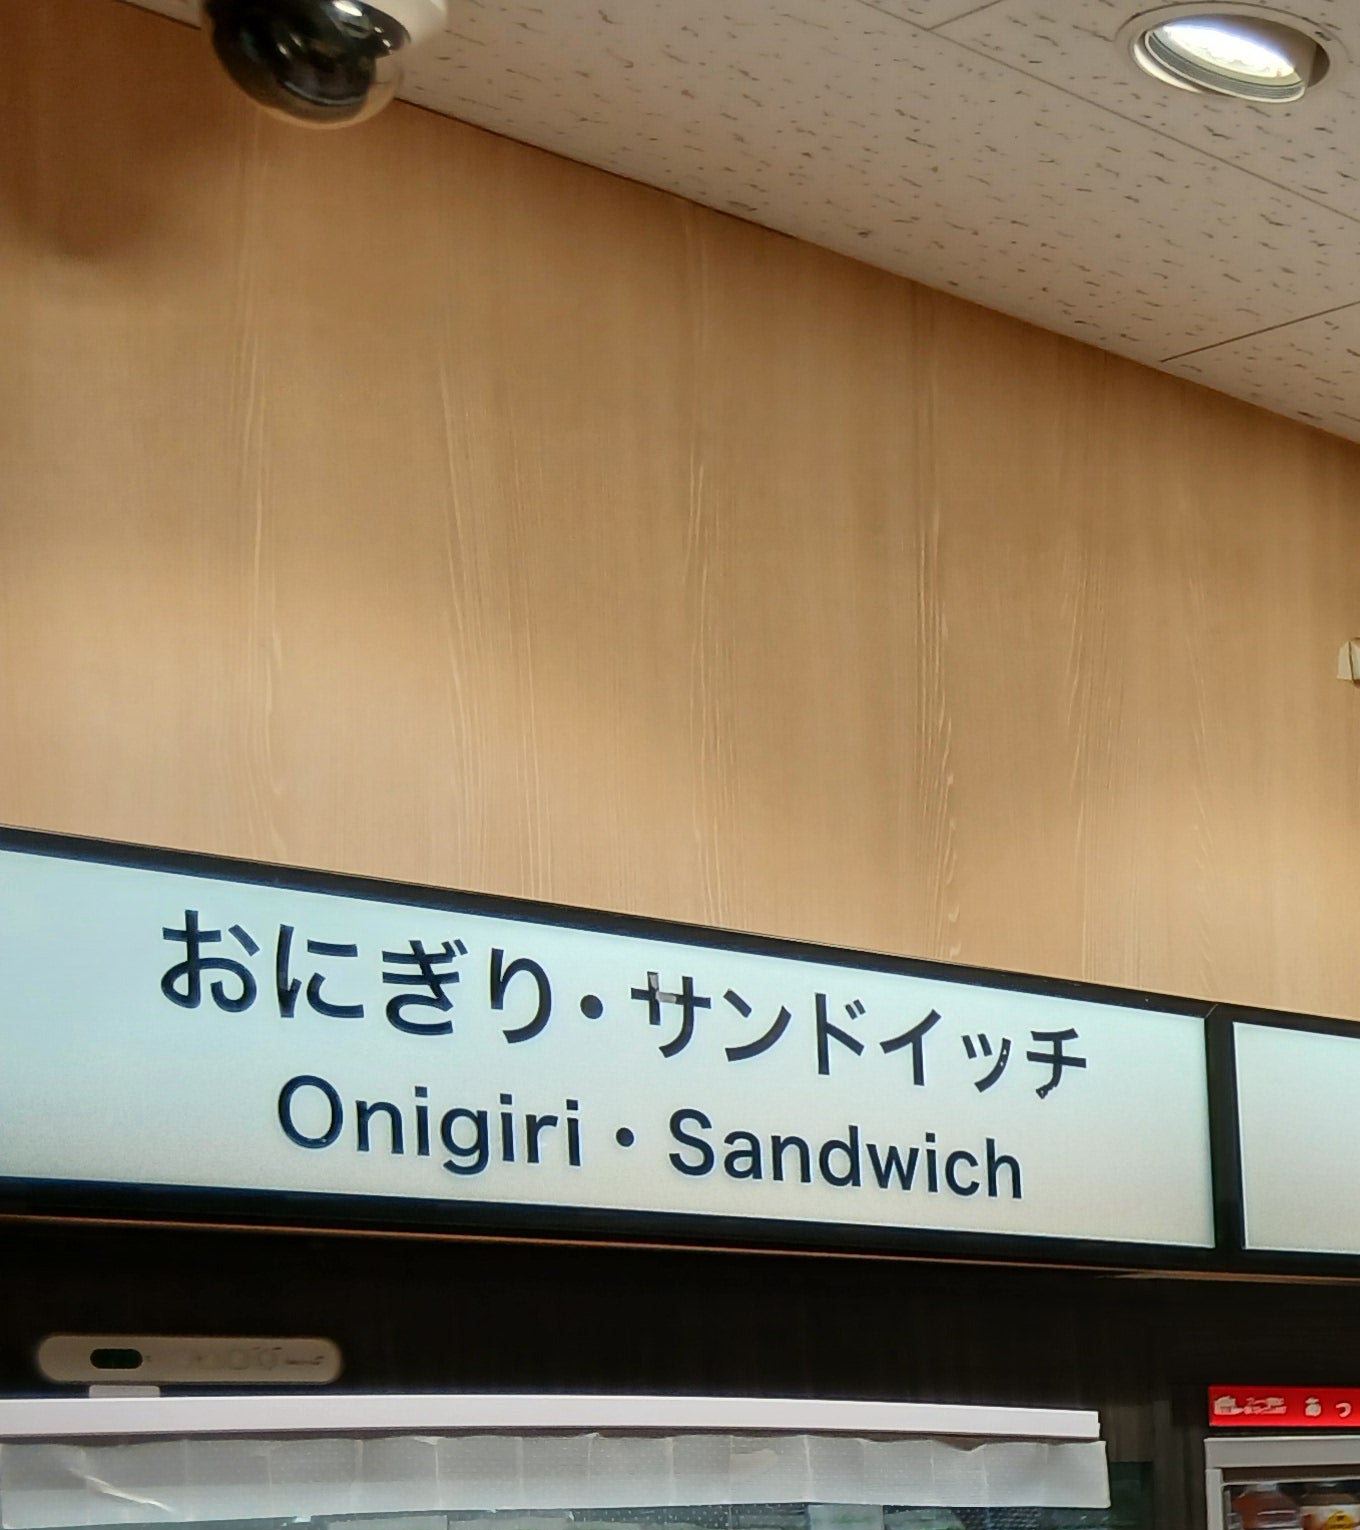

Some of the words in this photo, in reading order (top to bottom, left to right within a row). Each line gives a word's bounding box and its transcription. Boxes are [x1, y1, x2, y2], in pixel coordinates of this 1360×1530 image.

[160, 909, 1088, 1100] おにぎり・サンドイッチ
[277, 1074, 583, 1176] Onigiri
[667, 1109, 1023, 1200] Sandwich
